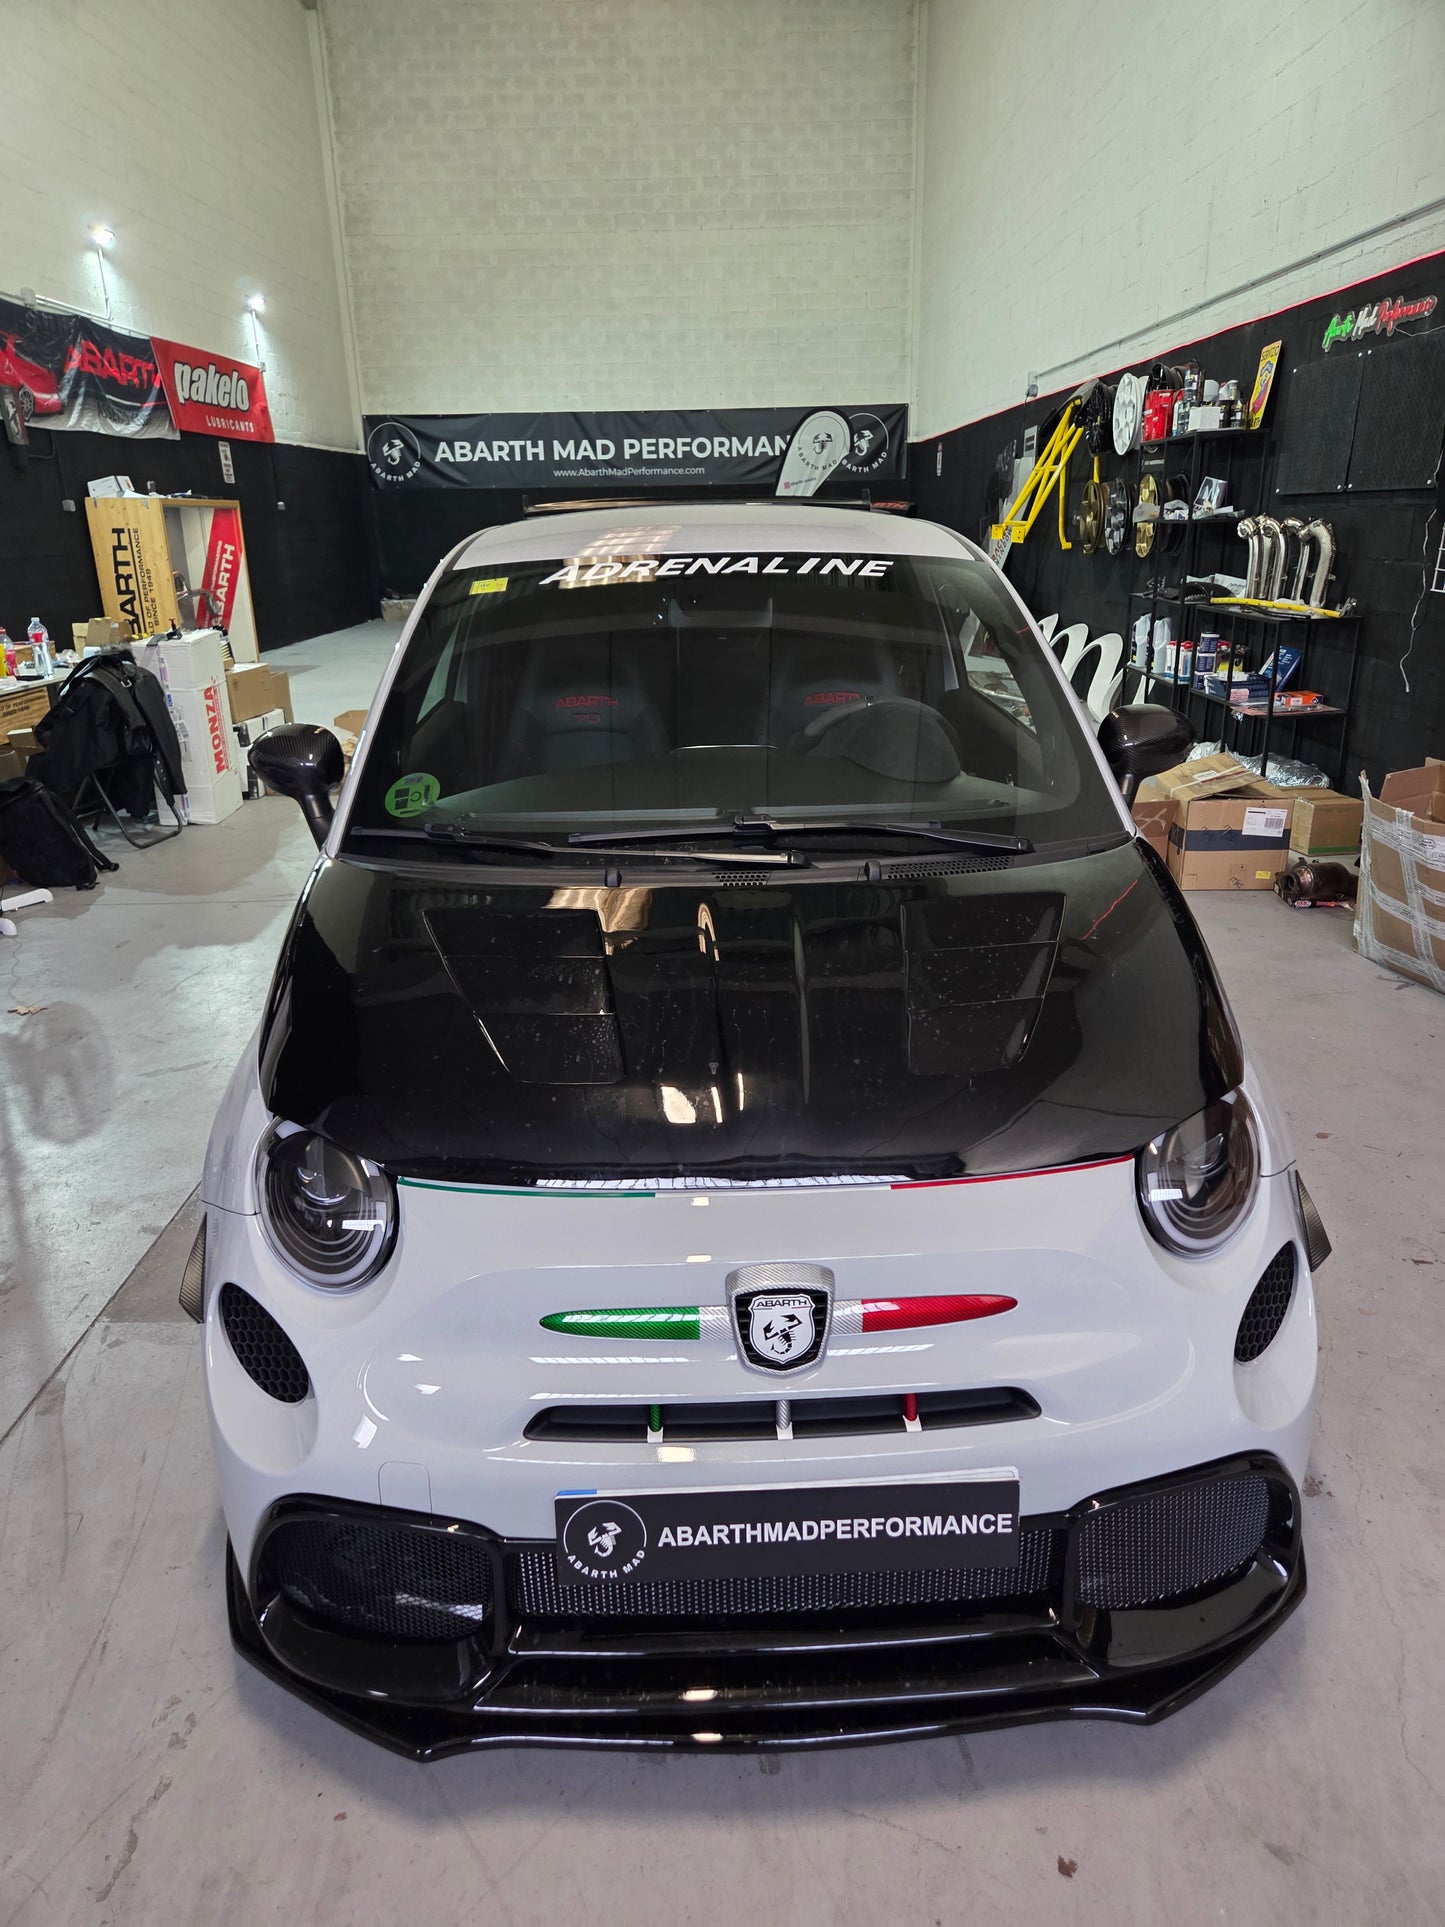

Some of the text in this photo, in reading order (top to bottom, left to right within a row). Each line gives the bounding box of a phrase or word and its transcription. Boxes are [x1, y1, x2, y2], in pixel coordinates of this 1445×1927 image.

[173, 361, 250, 412] pakelo
[205, 415, 254, 433] LUBRICANTS
[434, 435, 790, 462] ABARTH MAD PERFORMAN
[797, 446, 838, 471] ABARTH MAD
[370, 461, 420, 481] ABARTH MAD
[553, 466, 705, 477] www.AbarthMadPerformance.com
[841, 451, 887, 473] BARTH MAD
[133, 528, 150, 604] PERFORMANCE
[538, 556, 894, 585] ADRENALINE
[112, 528, 141, 635] BARTH
[145, 569, 160, 626] SINCE 1949
[145, 605, 153, 616] OF
[555, 696, 618, 708] ABARTH
[804, 692, 860, 704] ABART
[203, 685, 226, 774] MONZA
[756, 1299, 807, 1307] ABARTH
[657, 1513, 1013, 1547] ABARTHMADPERFORMANCE
[567, 1550, 645, 1579] ABARTH MAD
